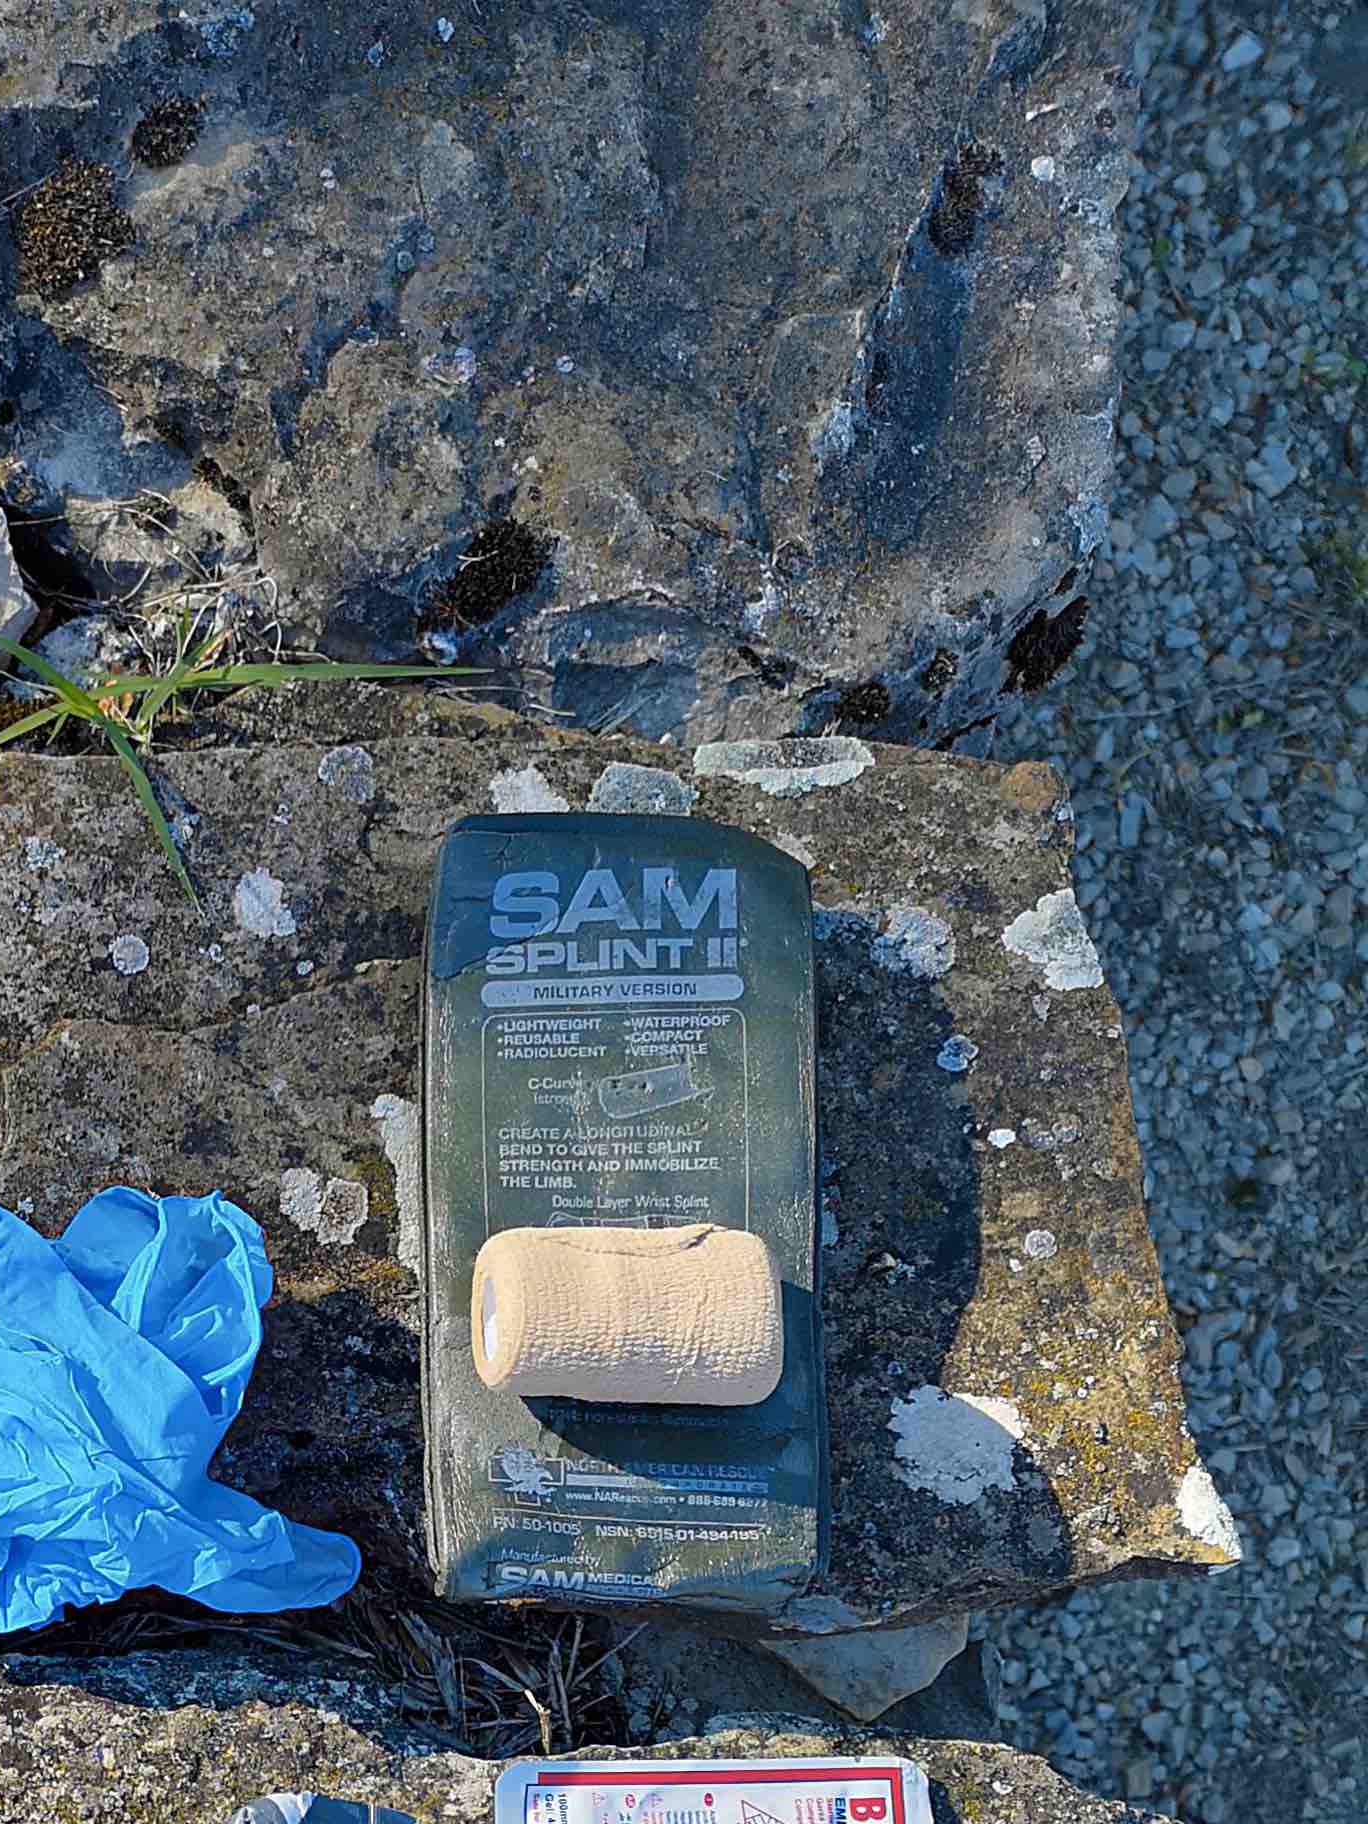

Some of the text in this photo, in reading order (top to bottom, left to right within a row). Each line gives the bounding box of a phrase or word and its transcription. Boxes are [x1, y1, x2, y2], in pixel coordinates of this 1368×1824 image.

[490, 868, 737, 939] SAM
[485, 937, 737, 975] SPLINT II
[534, 982, 697, 1000] MILITARY VERSION
[503, 1017, 602, 1033] LIGHTWEIGHT
[631, 1014, 731, 1029] WATERPROOF
[503, 1031, 581, 1046] REUSABLE
[631, 1029, 704, 1043] COMPACT
[503, 1046, 606, 1060] RADIOLUCENT
[631, 1043, 709, 1057] VERSATILE
[498, 1127, 560, 1141] CREATE
[499, 1140, 703, 1156] BEND TO GIVE THE SPLINT
[499, 1157, 720, 1172] STRENGTH AND IMMOBILIZE
[500, 1175, 577, 1189] THE LIMB.
[552, 1194, 709, 1212] Double Layer Wrist Splint
[501, 1564, 585, 1590] SAM
